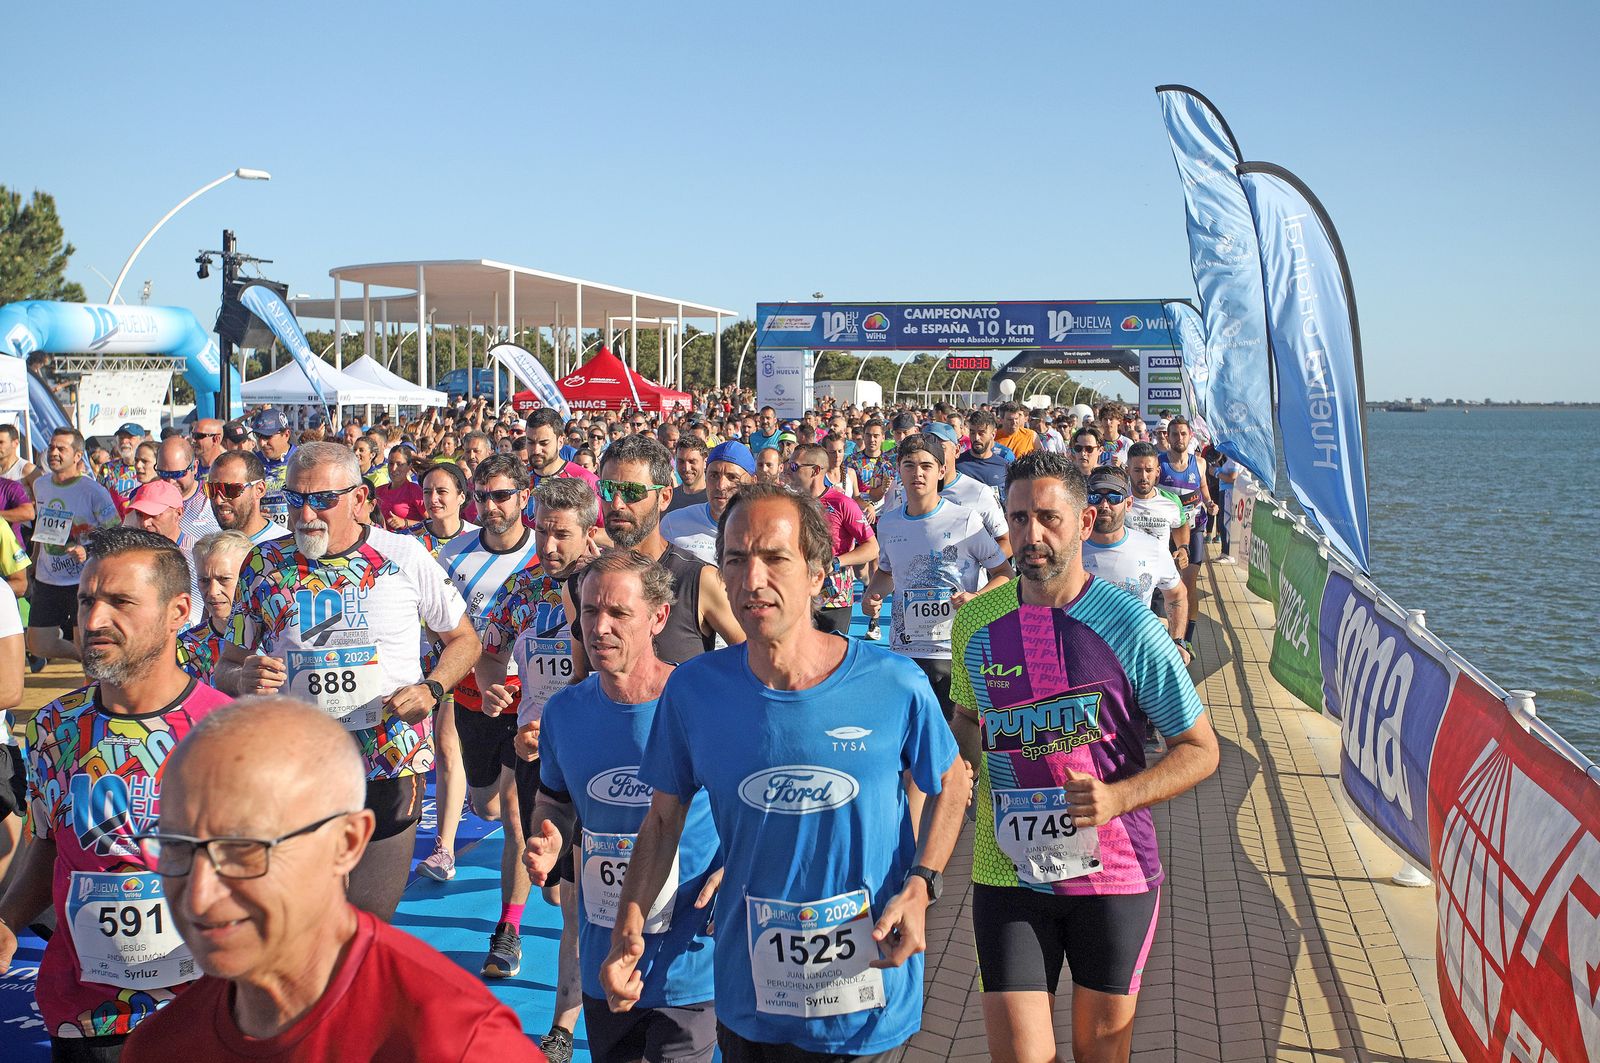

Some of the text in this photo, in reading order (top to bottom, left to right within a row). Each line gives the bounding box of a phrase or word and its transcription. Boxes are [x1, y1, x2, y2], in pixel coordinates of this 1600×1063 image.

[904, 308, 1000, 319] CAMPEONATO
[903, 320, 1034, 335] de ESPAÑA 10 km
[1072, 316, 1111, 329] HUELVA
[1146, 318, 1174, 330] WiH
[43, 517, 67, 529] 1014
[343, 587, 369, 600] HU
[344, 601, 369, 613] EL
[912, 602, 950, 617] 1680
[296, 589, 342, 646] 10
[344, 614, 369, 627] VA
[303, 655, 323, 664] HUELVA
[344, 652, 370, 663] 2023
[308, 671, 356, 696] 888
[832, 742, 867, 751] TYSA
[763, 772, 833, 804] Ford
[1008, 813, 1077, 841] 1749
[1039, 864, 1066, 873] Syrluz
[92, 883, 119, 893] HUELVA
[770, 910, 796, 922] HUELVA
[825, 901, 858, 922] 2023
[98, 903, 163, 938] 591
[121, 943, 147, 952] JESÚS
[769, 928, 856, 966] 1525
[137, 950, 166, 962] LIMÓN
[124, 968, 158, 980] Syrluz
[786, 970, 842, 980] JUAN IGNACIO
[767, 979, 814, 990] PERUCHENA
[806, 995, 839, 1007] Syrluz
